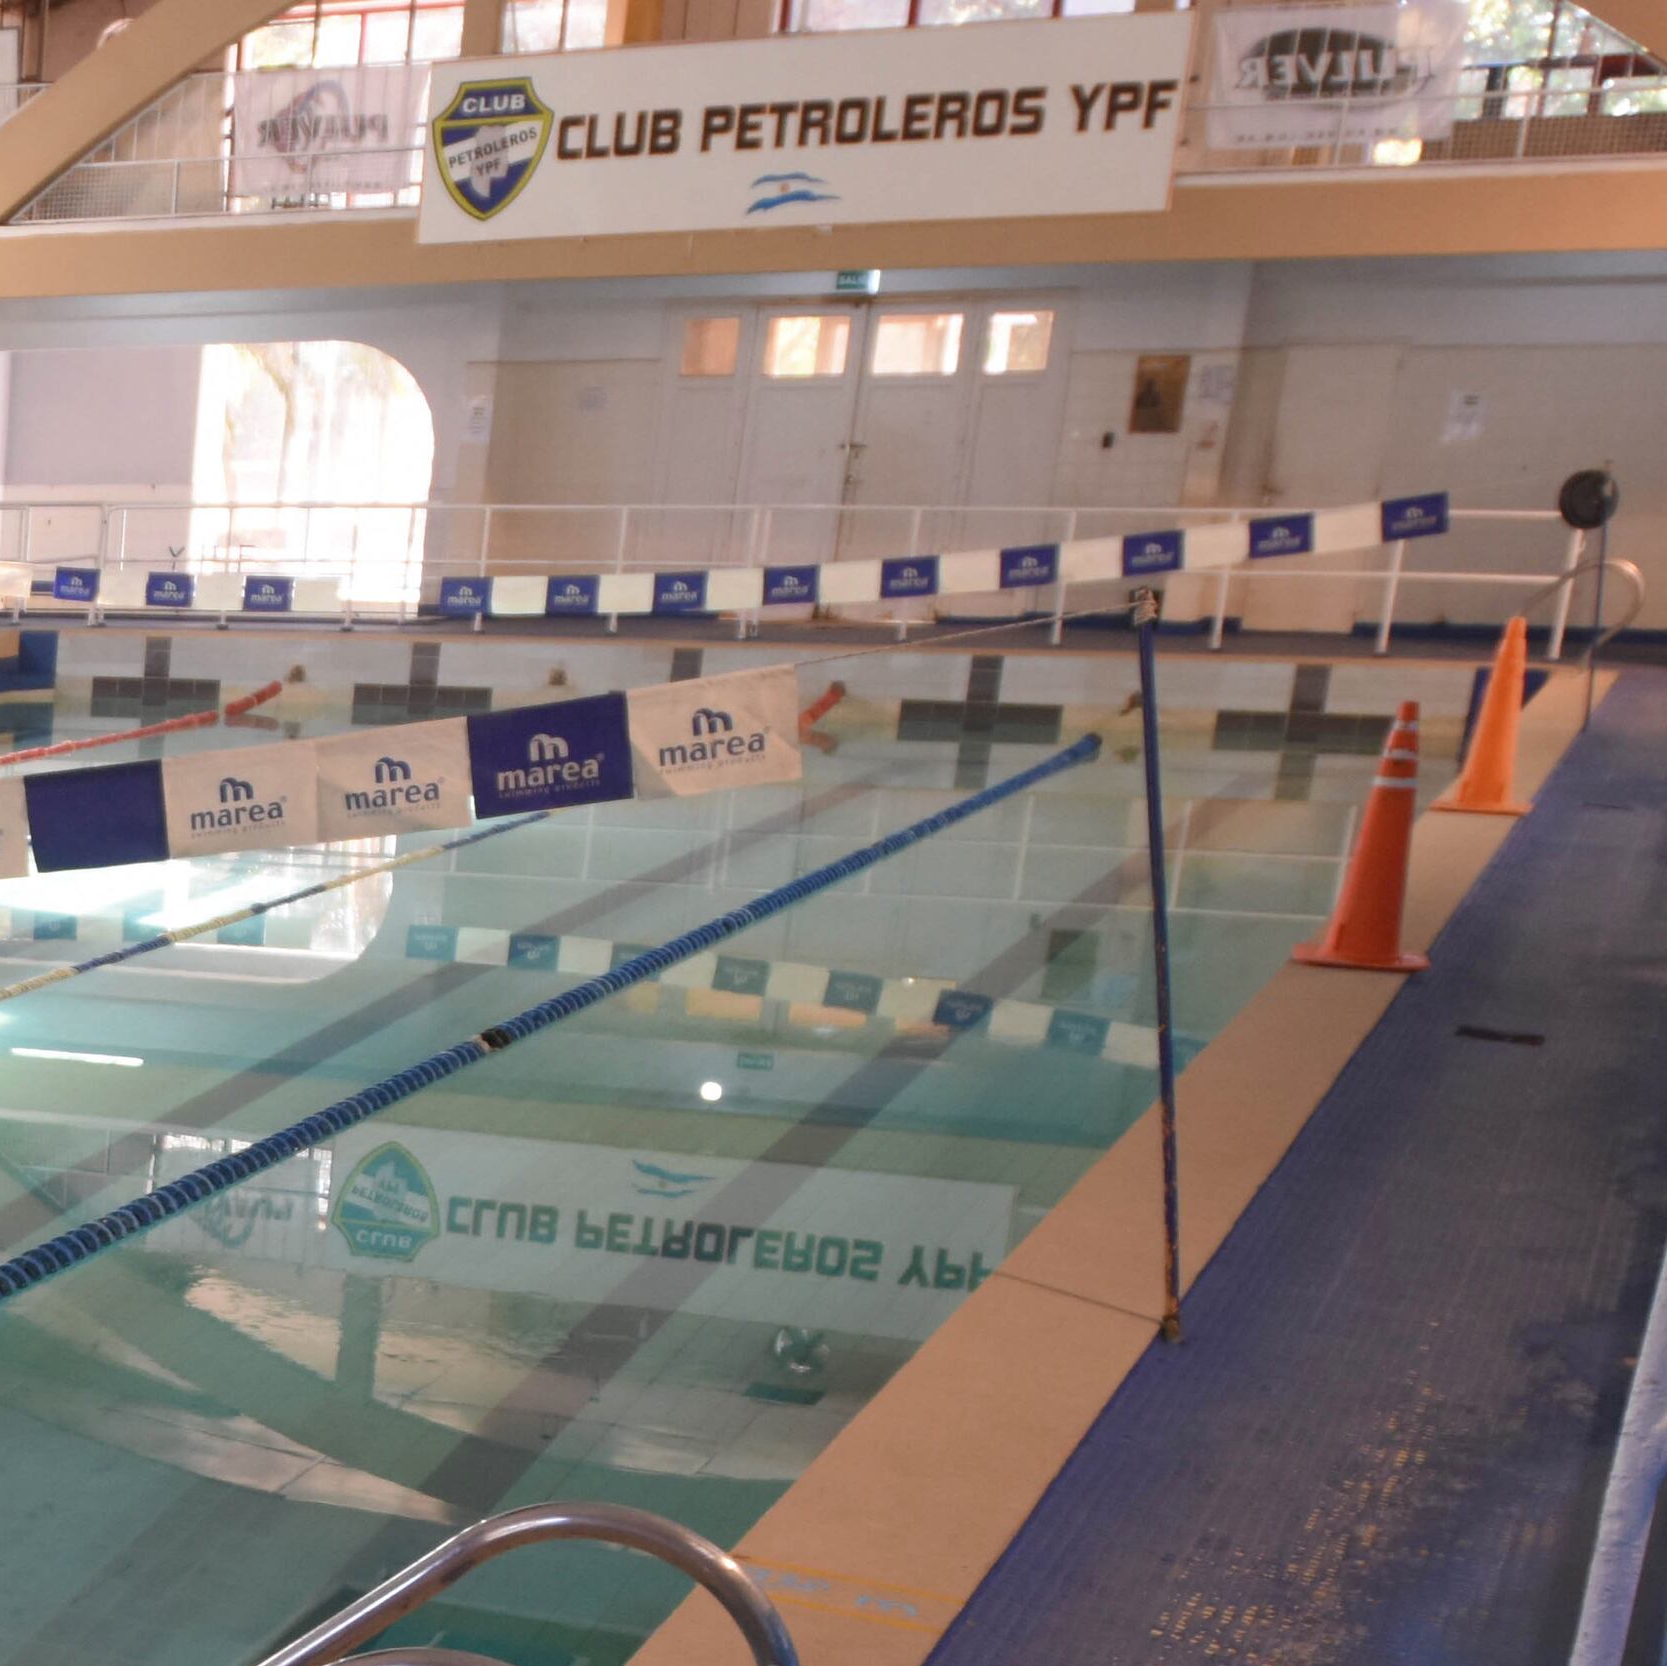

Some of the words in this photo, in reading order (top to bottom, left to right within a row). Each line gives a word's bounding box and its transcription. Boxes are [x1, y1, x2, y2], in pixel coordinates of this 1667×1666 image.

[462, 93, 525, 113] CLUB
[557, 109, 682, 160] CLUB
[700, 87, 1048, 153] PETROLEROS
[1070, 80, 1178, 131] YPF
[448, 127, 538, 168] PETROLEROS
[475, 159, 502, 178] YPF
[659, 732, 766, 766] marea
[497, 761, 599, 790] marea
[345, 782, 440, 810] marea
[191, 800, 284, 831] marea
